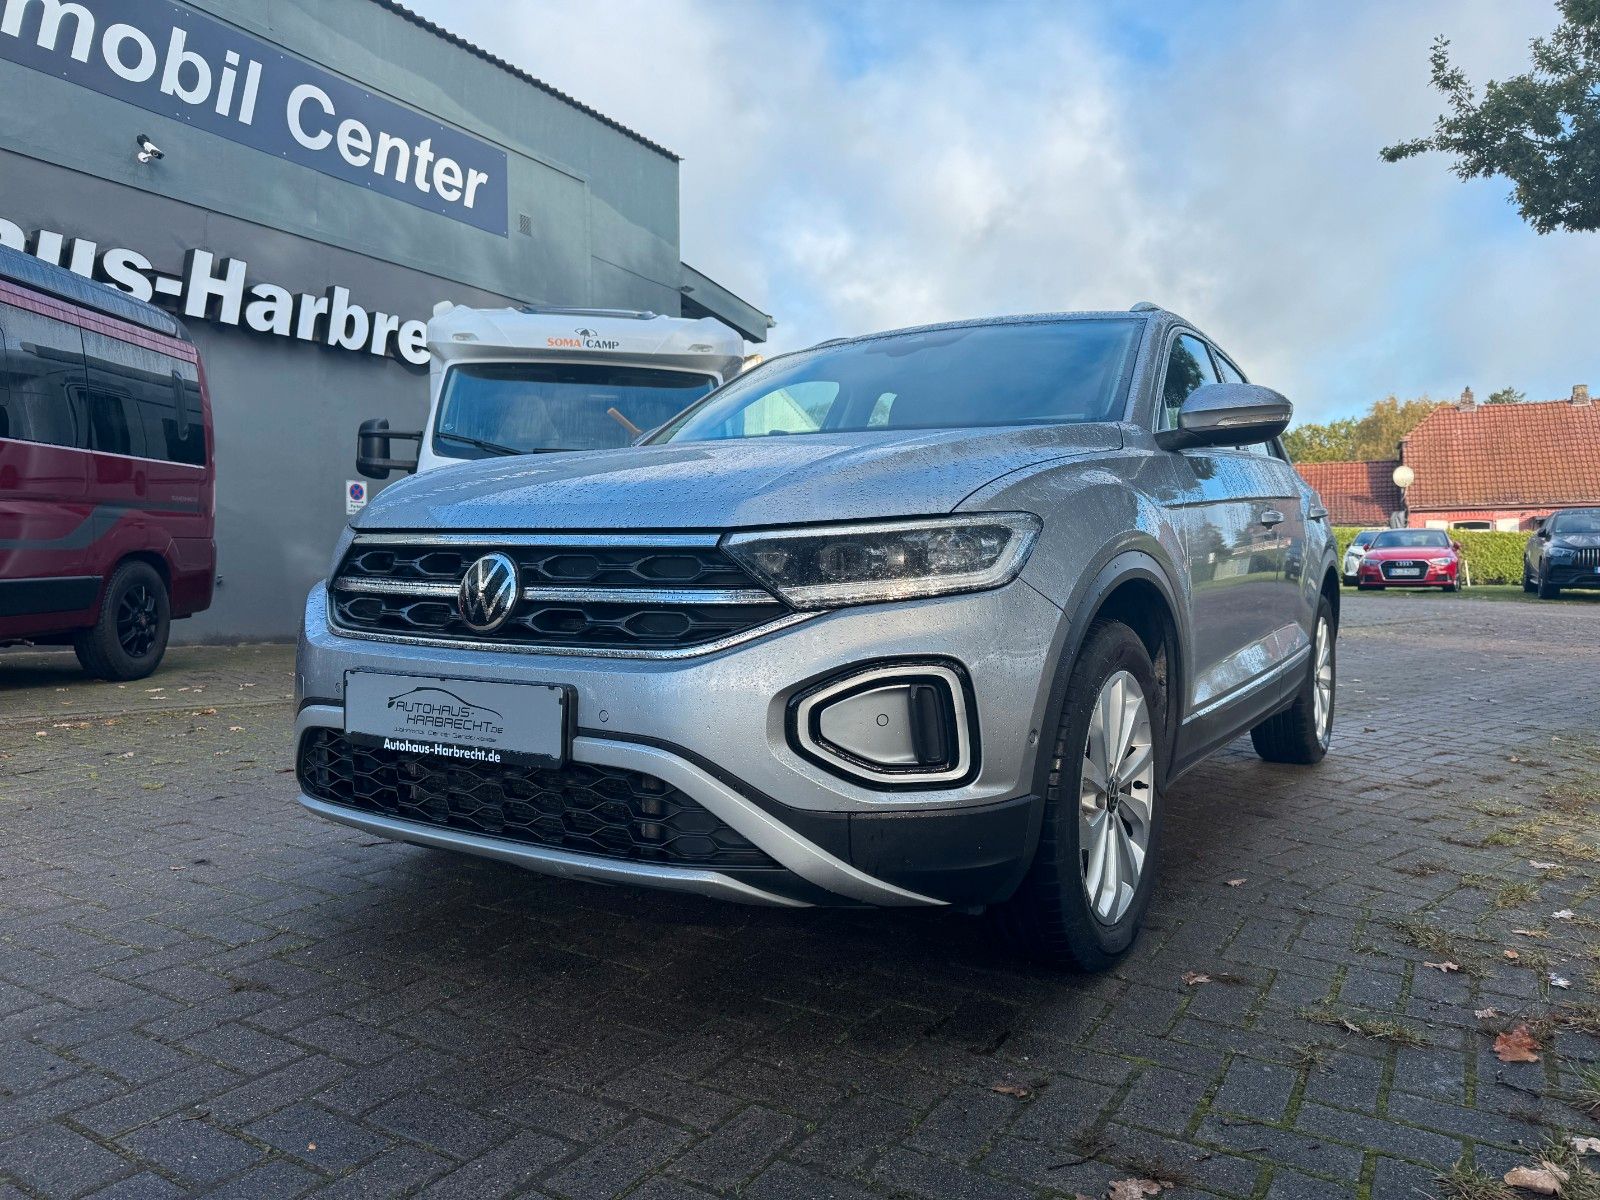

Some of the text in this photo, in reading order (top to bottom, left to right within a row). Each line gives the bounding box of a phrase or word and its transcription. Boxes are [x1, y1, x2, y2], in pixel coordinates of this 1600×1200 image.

[0, 0, 489, 209] mobil Center
[547, 337, 619, 349] SOMA CAMP
[384, 738, 501, 762] Autohaus-Harbrecht.de
